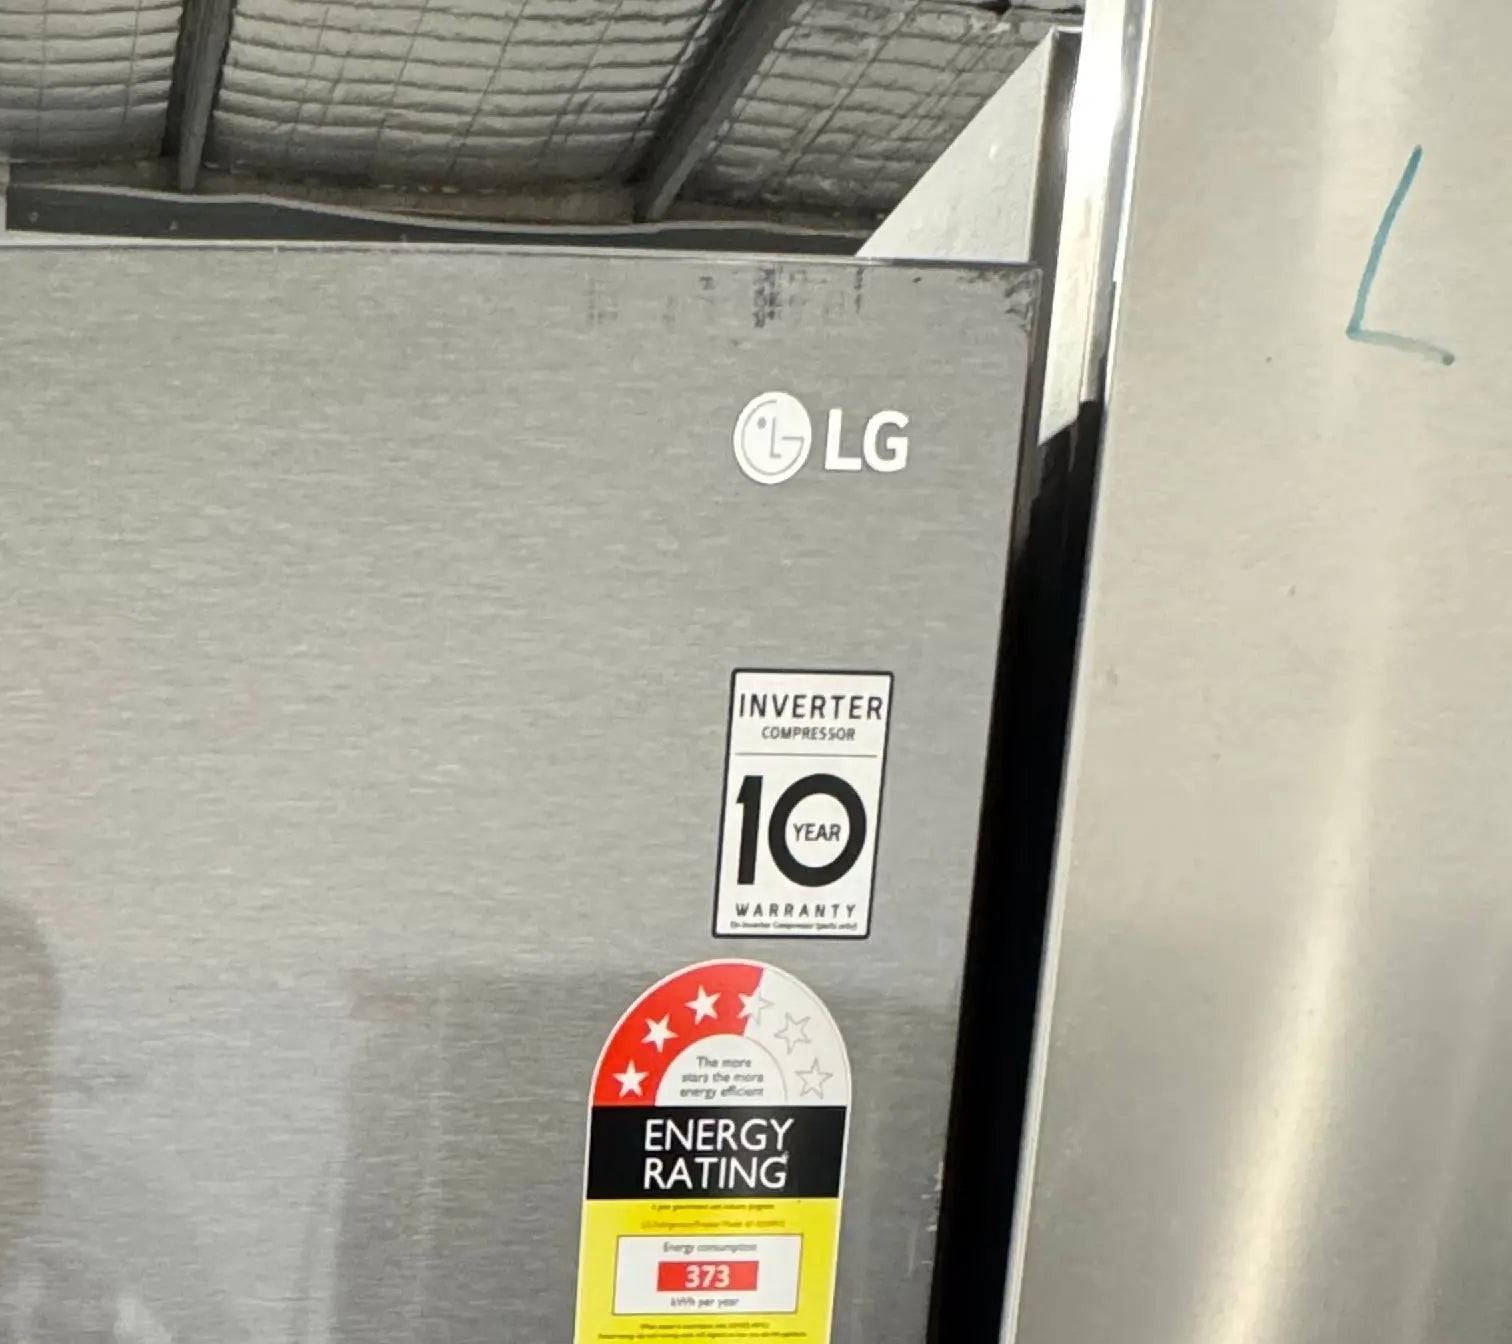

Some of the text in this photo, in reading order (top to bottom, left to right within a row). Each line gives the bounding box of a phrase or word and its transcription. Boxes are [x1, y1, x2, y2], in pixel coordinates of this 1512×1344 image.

[825, 408, 910, 473] LG
[739, 693, 884, 721] INVERTER
[761, 725, 856, 741] COMPRESSOR
[736, 773, 867, 888] 10
[793, 823, 841, 842] YEAR
[735, 902, 857, 918] WARRANTY
[697, 1056, 751, 1068] The more
[681, 1072, 764, 1084] stars the more
[680, 1086, 764, 1100] energy efficient
[645, 1118, 794, 1151] ENERGY
[644, 1156, 788, 1190] RATING
[663, 1241, 695, 1255] Energy
[684, 1264, 731, 1289] 373
[698, 1298, 715, 1310] per
[718, 1299, 739, 1310] year
